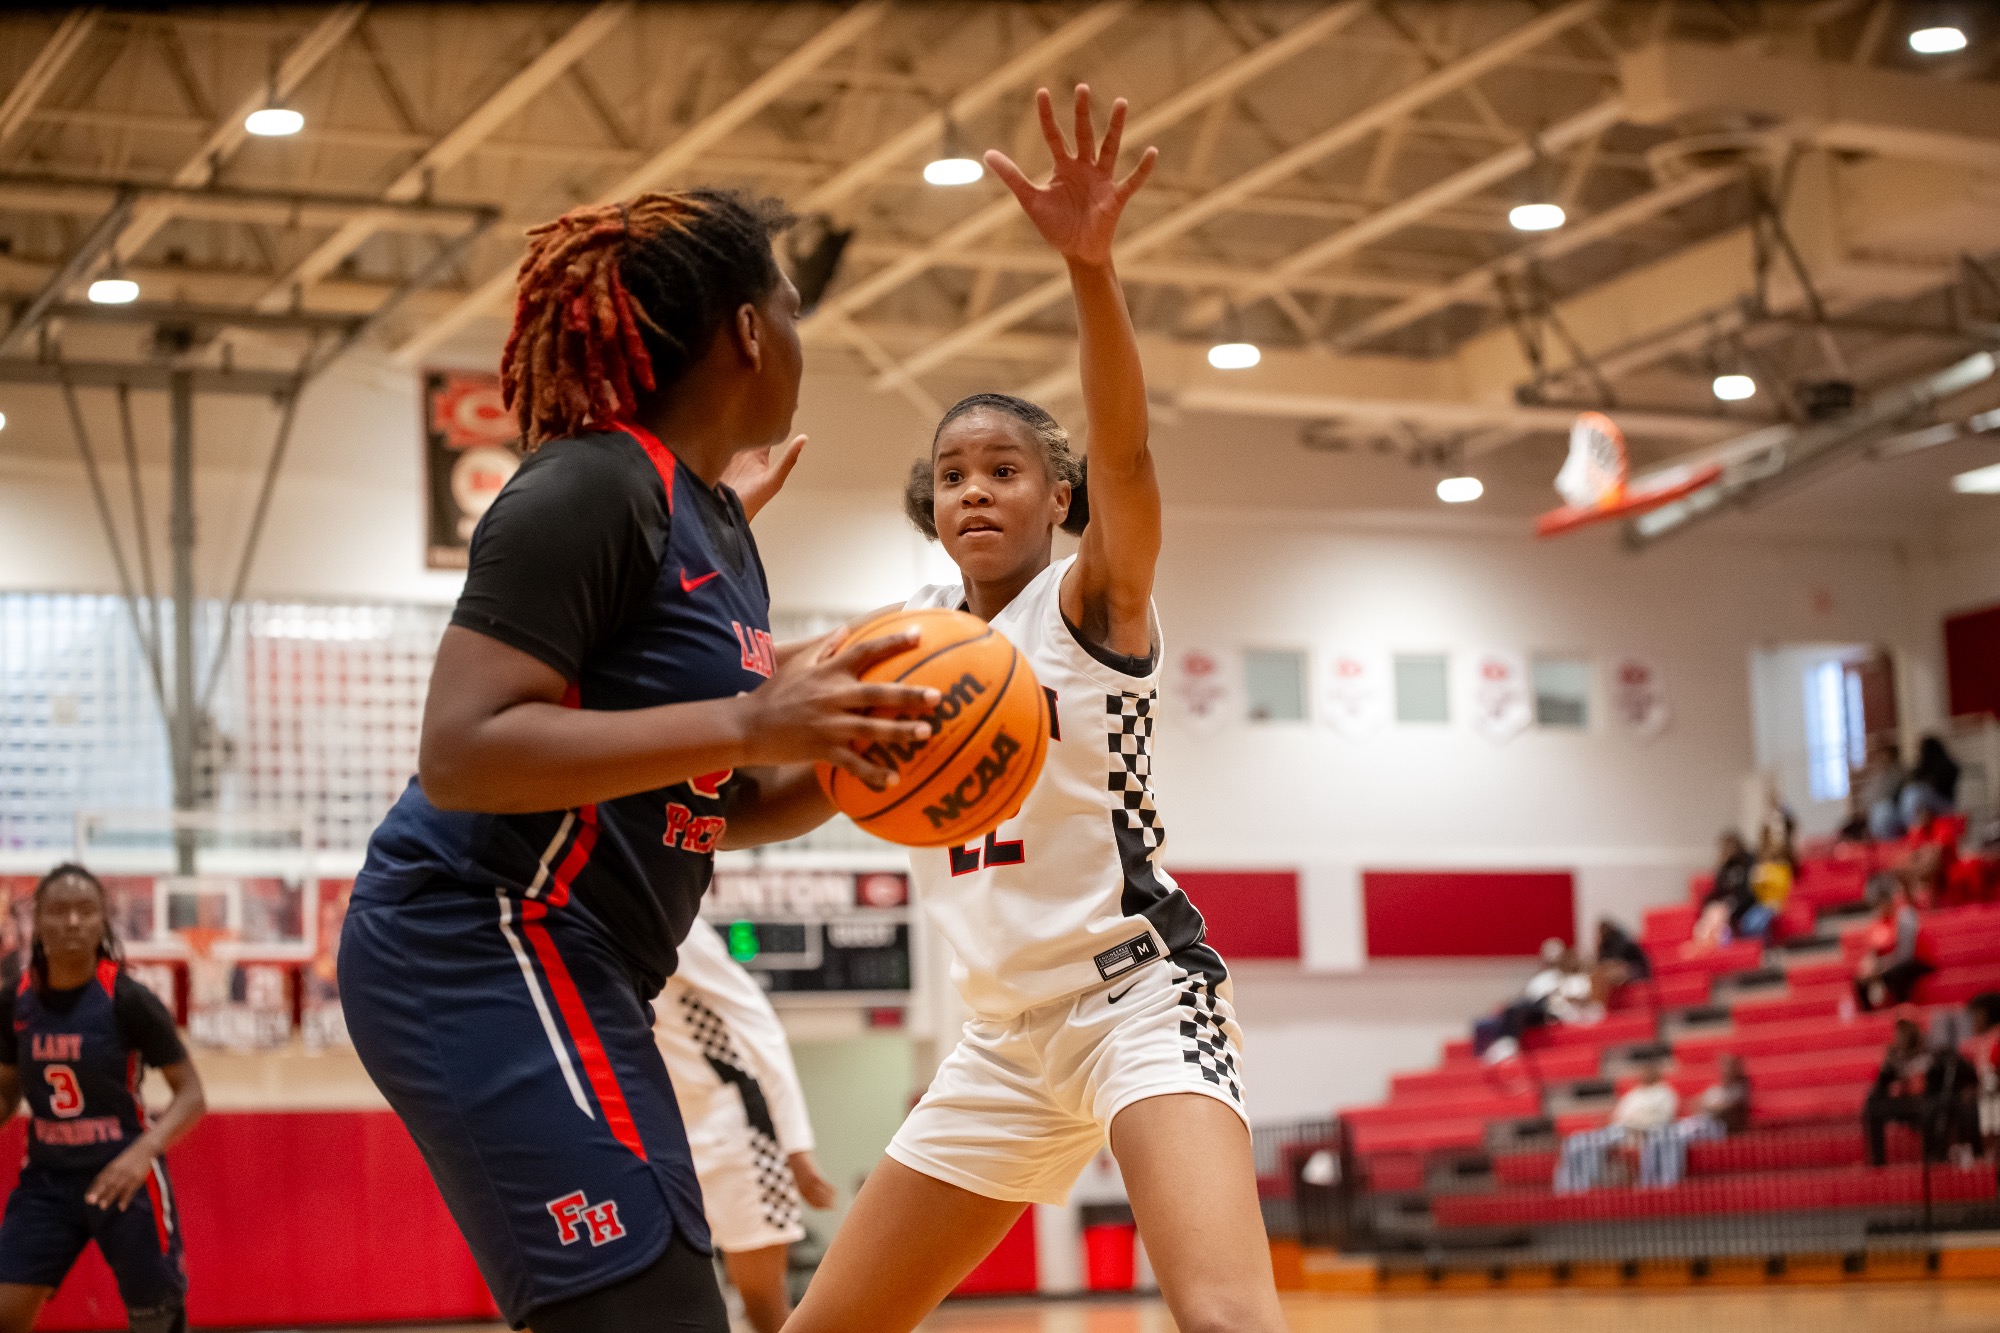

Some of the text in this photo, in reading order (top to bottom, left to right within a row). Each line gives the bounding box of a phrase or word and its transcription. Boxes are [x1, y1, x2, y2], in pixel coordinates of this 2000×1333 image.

[922, 731, 1021, 829] NCAA
[1136, 942, 1150, 956] M
[43, 1063, 85, 1118] 3
[545, 1188, 627, 1248] FH
